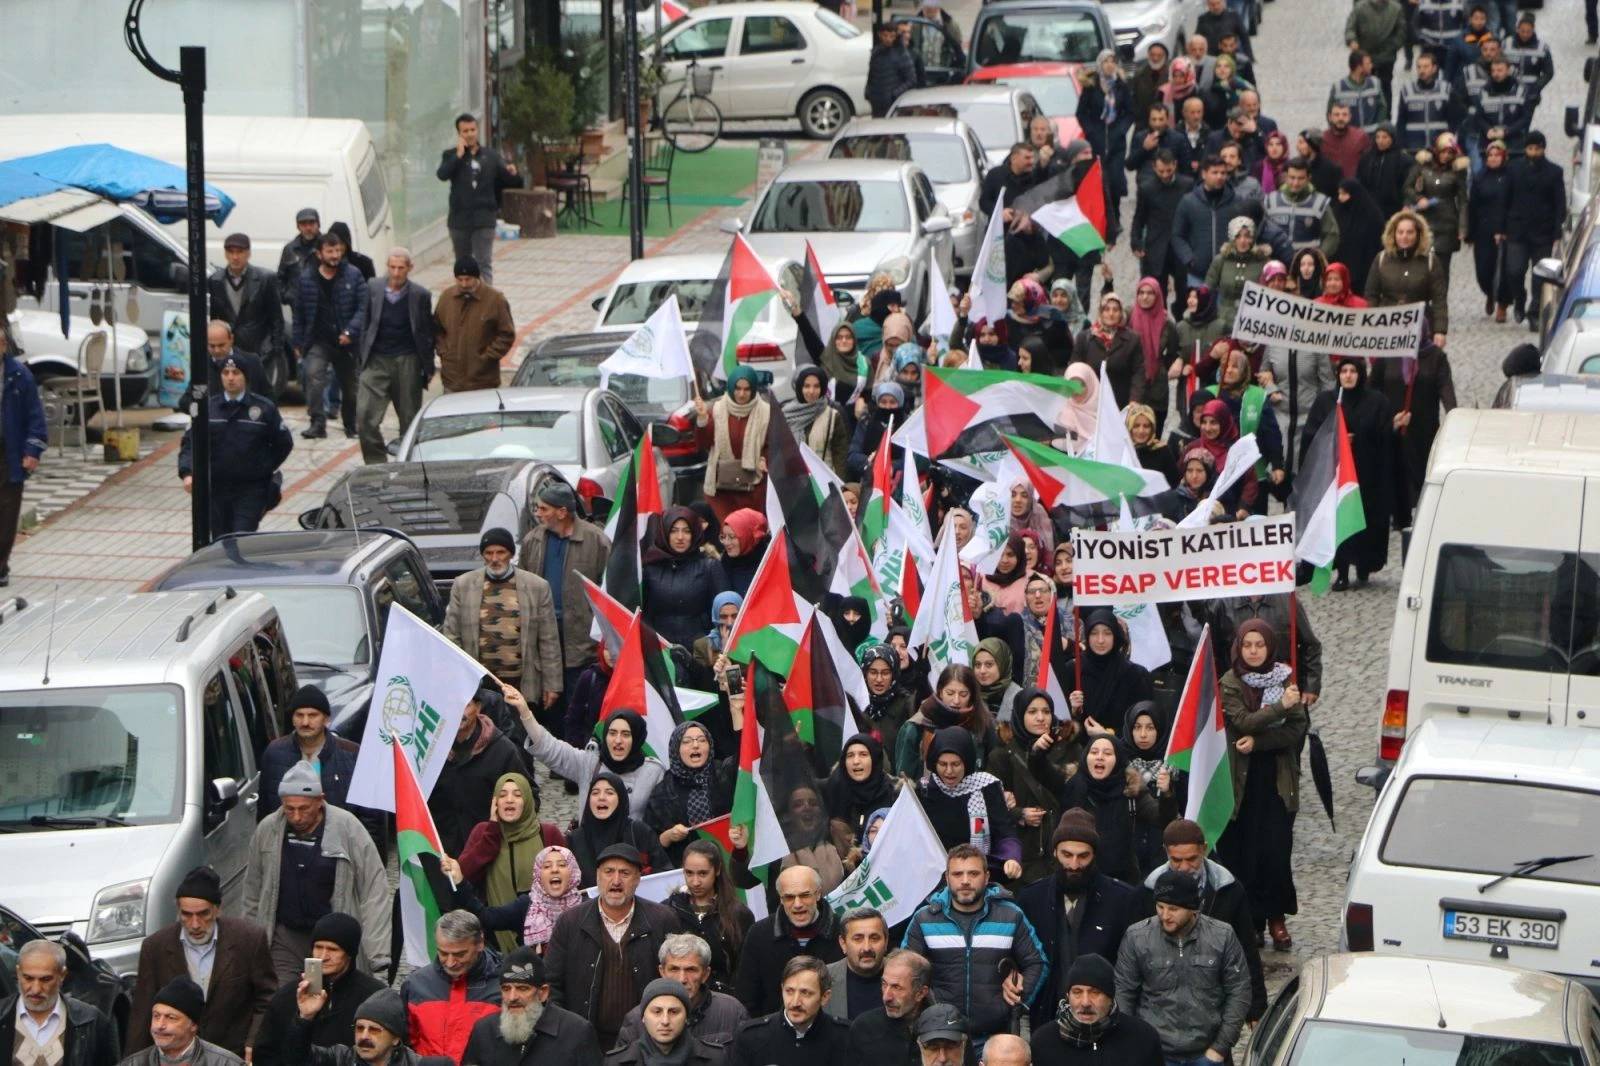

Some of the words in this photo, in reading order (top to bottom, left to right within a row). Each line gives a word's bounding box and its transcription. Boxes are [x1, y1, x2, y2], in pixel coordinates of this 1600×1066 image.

[1244, 288, 1357, 326] SİYONİZME
[1361, 309, 1419, 328] KARŞI
[1239, 315, 1289, 340] YAŞASIN
[1290, 323, 1331, 346] İSLAMİ
[1332, 330, 1417, 350] MÜCADELEMİZ
[1182, 522, 1293, 555] KATİLLER
[1163, 559, 1295, 591] VERECEK
[1436, 674, 1493, 688] TRANSIT
[1455, 915, 1480, 934] 53
[1487, 918, 1511, 937] EK
[1519, 921, 1556, 942] 390
